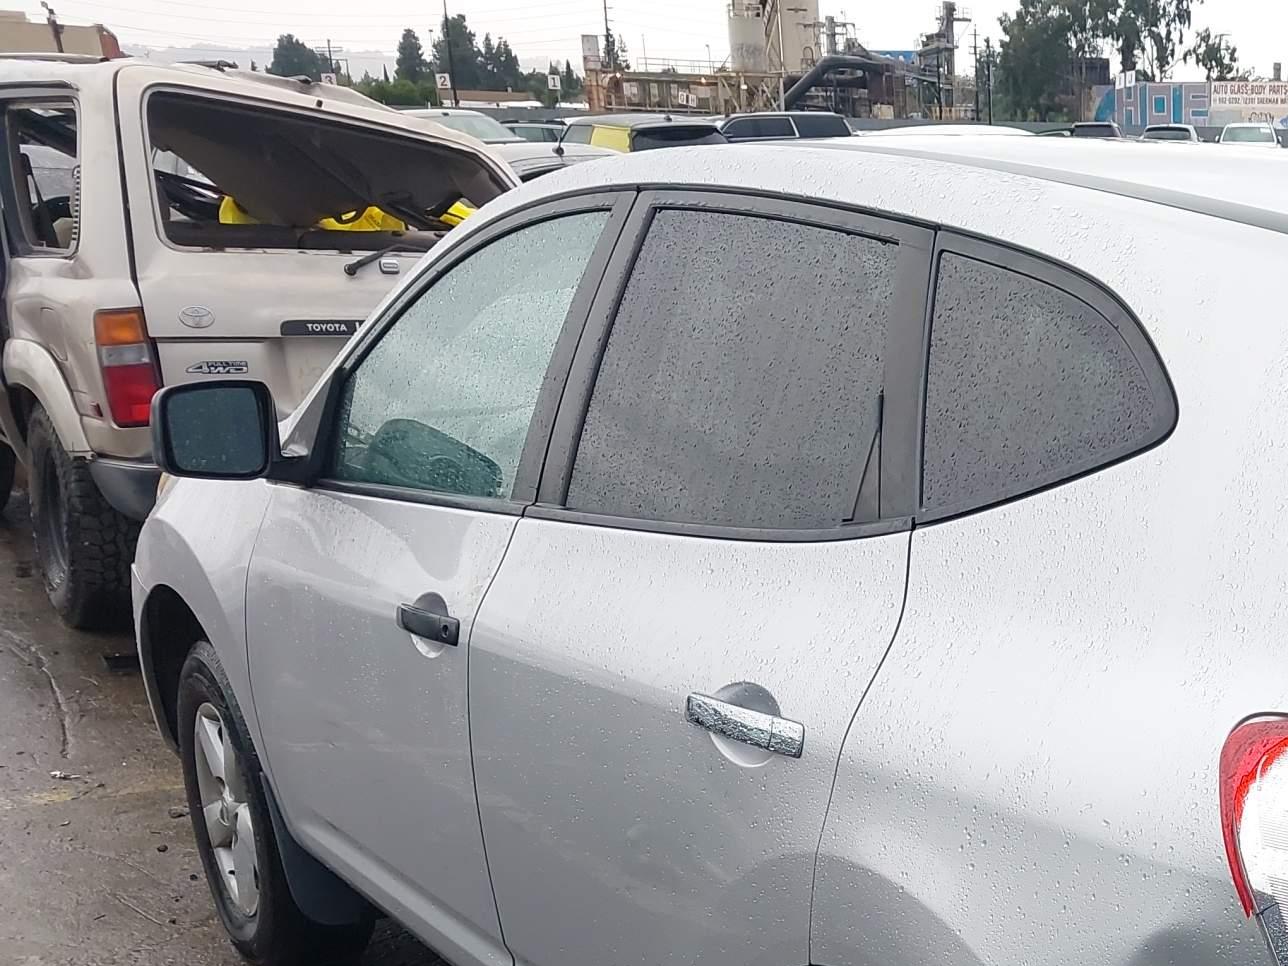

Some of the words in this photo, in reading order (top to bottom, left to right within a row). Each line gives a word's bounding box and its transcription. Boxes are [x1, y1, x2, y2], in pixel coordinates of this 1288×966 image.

[440, 75, 448, 87] 2
[1213, 84, 1228, 95] AUTO
[306, 323, 348, 332] TOYOTA
[186, 360, 248, 374] 4WD
